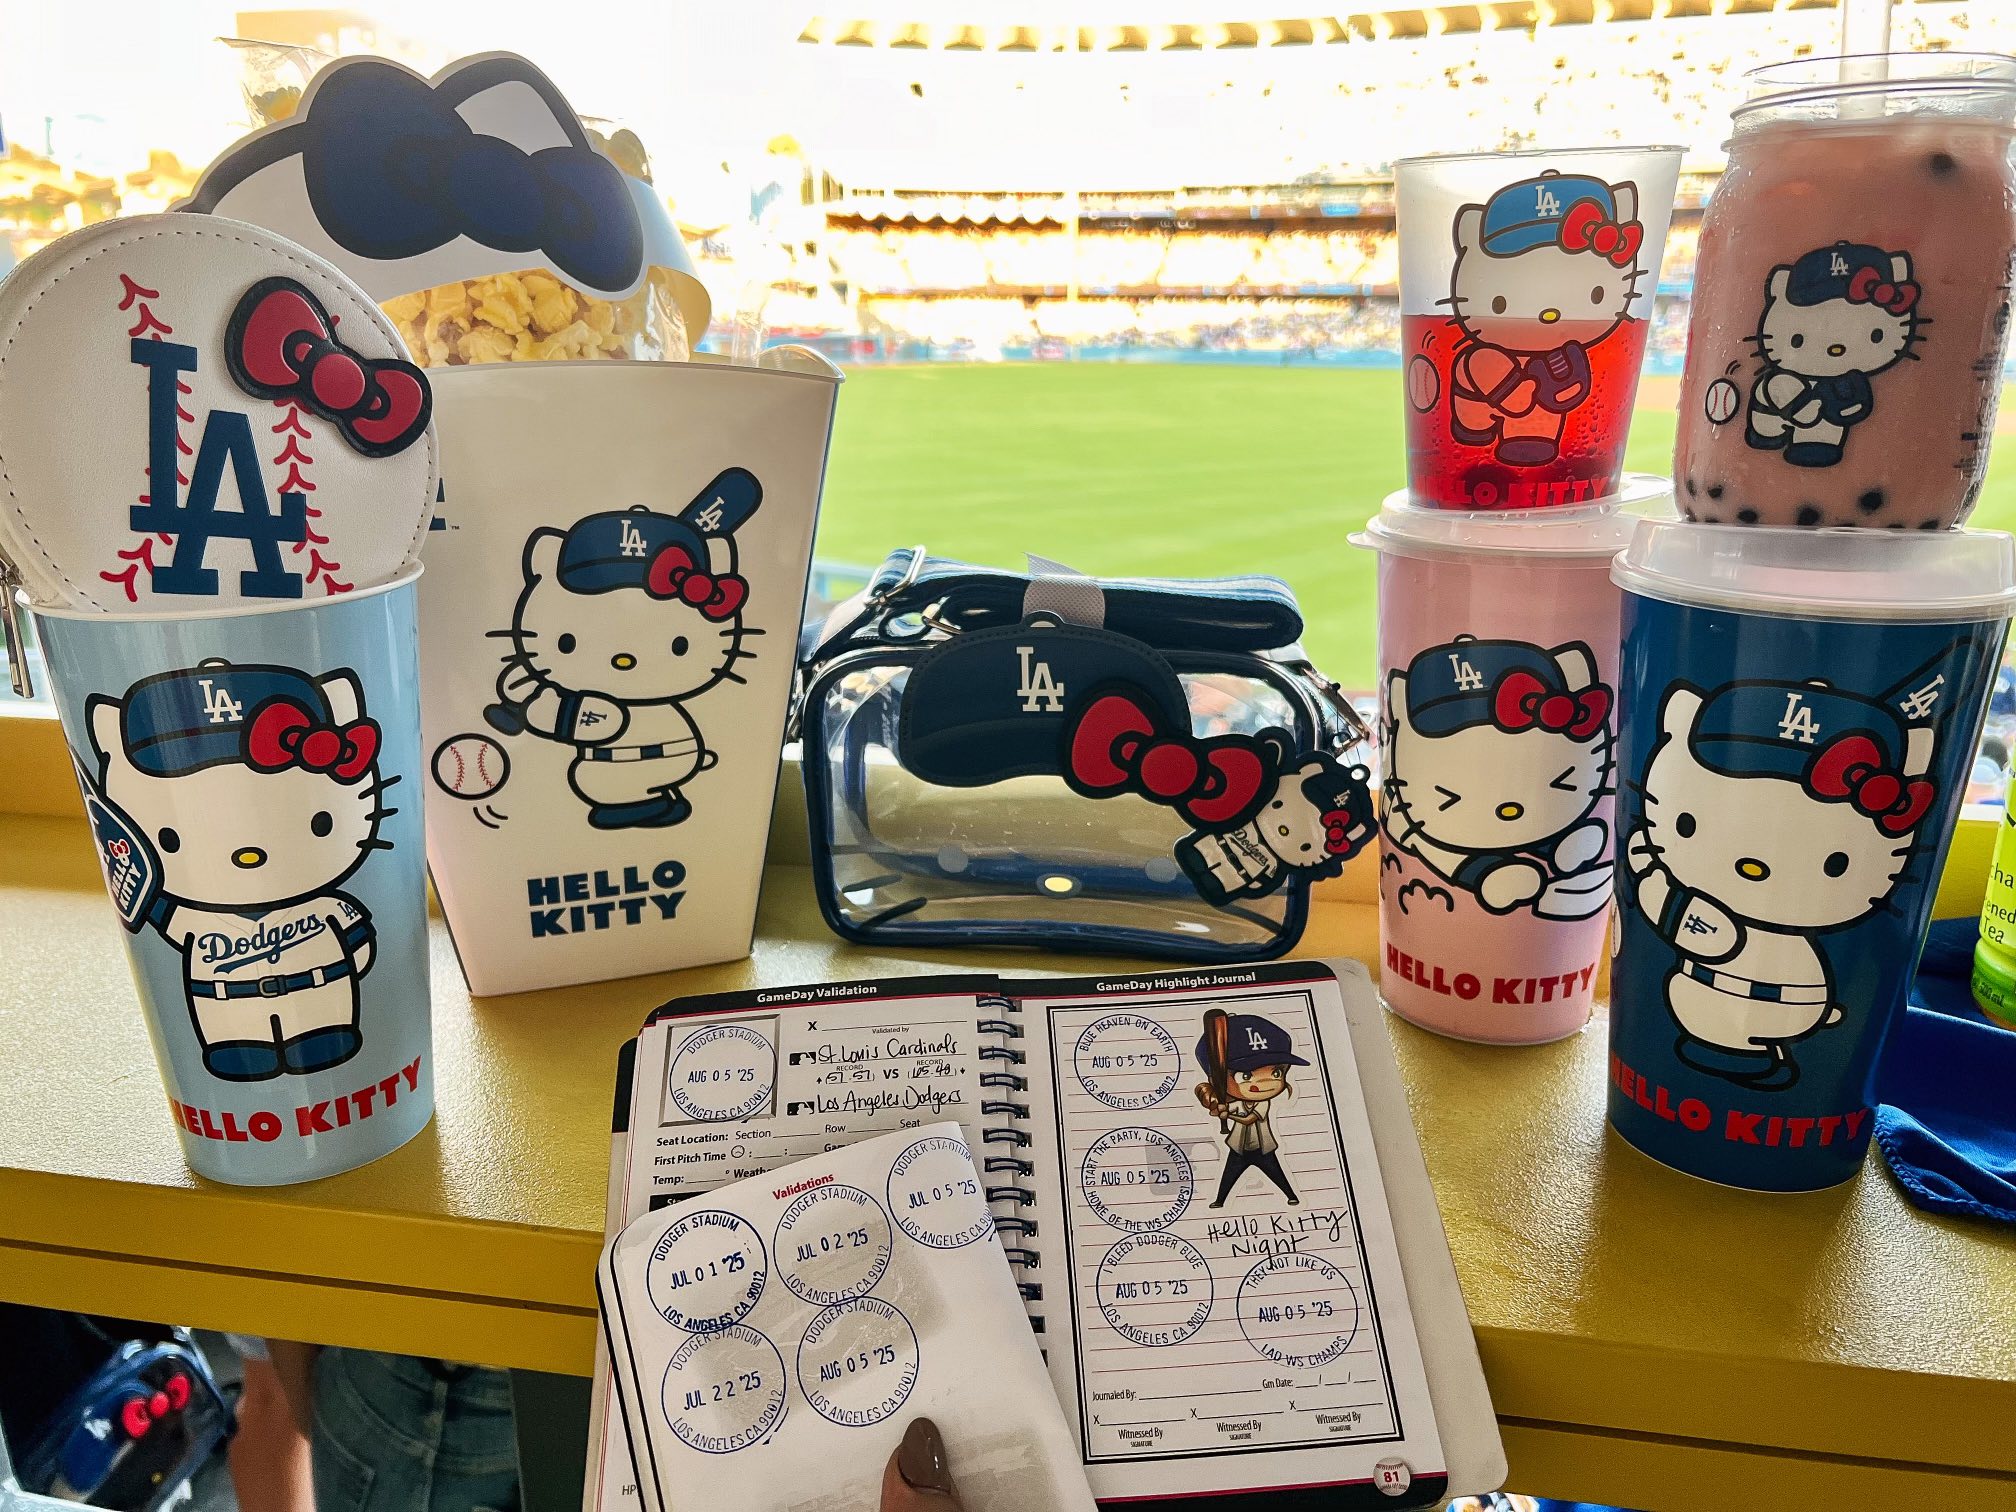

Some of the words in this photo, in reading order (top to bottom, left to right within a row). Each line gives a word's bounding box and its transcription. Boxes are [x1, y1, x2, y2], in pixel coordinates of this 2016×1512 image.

[1535, 184, 1561, 217] LA
[1830, 252, 1848, 276] LA
[130, 337, 306, 598] LA
[1507, 476, 1609, 507] KITTY
[695, 497, 725, 532] LA
[620, 519, 647, 556] LA
[1016, 646, 1064, 712] LA
[1449, 653, 1484, 692] LA
[198, 679, 242, 722] LA
[1900, 673, 1945, 720] LA
[1777, 692, 1819, 743] LA
[527, 860, 687, 906] HELLO
[337, 901, 360, 921] LA
[530, 890, 687, 938] KITTY
[1683, 912, 1719, 936] LA
[201, 914, 326, 974] Dodgers
[1984, 916, 2005, 945] Tea
[1096, 980, 1152, 992] GameDay
[1154, 975, 1210, 990] Highlight
[1211, 972, 1257, 984] Journal
[1387, 942, 1481, 1001] HELLO
[1492, 962, 1595, 1005] KITTY
[757, 989, 815, 1003] GameDay
[816, 985, 878, 998] Validation
[687, 1029, 725, 1054] DODGER
[728, 1029, 766, 1050] STADIUM
[872, 1026, 901, 1034] Validated
[887, 1033, 958, 1058] Cardinals
[1079, 1031, 1097, 1052] BLUE
[1095, 1017, 1131, 1033] HEAVEN
[1135, 1018, 1150, 1030] ON
[1150, 1026, 1174, 1053] EARTH
[1245, 1027, 1269, 1051] LA
[688, 1070, 707, 1083] AUG
[836, 1064, 864, 1072] RECORD
[883, 1069, 899, 1079] VS
[916, 1058, 944, 1066] RECORD
[1092, 1056, 1111, 1068] AUG
[295, 1055, 422, 1138] KITTY
[674, 1087, 688, 1105] LOS
[685, 1102, 728, 1120] ANGELES
[730, 1106, 744, 1117] CA
[743, 1083, 770, 1110] 90012
[817, 1094, 839, 1113] Los
[843, 1090, 899, 1116] Angeles
[902, 1085, 962, 1114] Dodgers
[1081, 1075, 1098, 1092] LOS
[1097, 1090, 1139, 1108] ANGELES
[1142, 1093, 1157, 1105] CA
[656, 1137, 679, 1147] Seat
[681, 1132, 729, 1145] Location:
[735, 1129, 771, 1140] Section
[825, 1124, 846, 1133] Row
[900, 1118, 921, 1128] Seat
[1725, 1107, 1866, 1149] KITTY
[654, 1155, 675, 1166] First
[677, 1153, 701, 1164] Pitch
[703, 1151, 727, 1161] Time
[894, 1143, 928, 1176] DODGER
[930, 1140, 972, 1162] STADIUM
[1086, 1157, 1098, 1186] START
[1093, 1140, 1111, 1156] THE
[1110, 1130, 1142, 1144] PARTY,
[1145, 1132, 1164, 1146] LOS
[1163, 1144, 1189, 1182] ANGELES
[653, 1175, 685, 1186] Temp:
[772, 1174, 834, 1200] Validations
[1101, 1171, 1121, 1185] AUG
[781, 1193, 819, 1230] DODGER
[820, 1188, 868, 1207] STADIUM
[908, 1191, 929, 1209] JUL
[1087, 1190, 1109, 1217] HOME
[1108, 1213, 1122, 1225] OF
[1124, 1219, 1142, 1231] THE
[1145, 1217, 1162, 1231] WS
[655, 1223, 689, 1261] DODGER
[692, 1214, 740, 1232] STADIUM
[900, 1216, 921, 1236] LOS
[920, 1231, 970, 1247] ANGELES
[969, 1223, 984, 1238] CA
[1207, 1216, 1258, 1244] Hello
[1270, 1210, 1348, 1243] Kitty
[796, 1243, 817, 1262] JUL
[1107, 1241, 1134, 1267] BLEED
[1136, 1234, 1178, 1250] DODGER
[1180, 1245, 1204, 1270] BLUE
[1231, 1234, 1310, 1271] Night
[670, 1270, 692, 1290] JUL
[786, 1273, 806, 1294] LOS
[805, 1287, 856, 1304] ANGELES
[856, 1278, 872, 1293] CA
[868, 1245, 889, 1280] 90012
[1245, 1265, 1269, 1290] THEY
[1271, 1257, 1290, 1271] NOT
[1295, 1256, 1318, 1271] LIKE
[1320, 1265, 1336, 1281] US
[663, 1305, 684, 1325] LOS
[684, 1312, 734, 1332] ANGELES
[734, 1301, 751, 1317] CA
[746, 1270, 765, 1301] 90012
[1115, 1282, 1137, 1299] AUG
[806, 1305, 844, 1344] DODGER
[846, 1300, 894, 1321] STADIUM
[1103, 1302, 1121, 1324] LOS
[1120, 1322, 1169, 1345] ANGELES
[1172, 1327, 1189, 1341] CA
[1186, 1302, 1209, 1330] 90012
[1259, 1306, 1280, 1323] AUG
[672, 1332, 712, 1371] DODGER
[715, 1326, 763, 1348] STADIUM
[1260, 1343, 1283, 1362] LAD
[1285, 1354, 1304, 1367] WS
[1308, 1335, 1348, 1366] CHAMPS
[820, 1360, 842, 1382] AUG
[1275, 1377, 1294, 1388] Date:
[684, 1390, 706, 1411] JUL
[809, 1390, 830, 1412] LOS
[828, 1406, 881, 1424] ANGELES
[881, 1397, 899, 1413] CA
[894, 1362, 916, 1399] 90012
[1092, 1390, 1125, 1401] Journaled
[672, 1417, 693, 1439] LOS
[691, 1433, 745, 1450] ANGELES
[745, 1424, 762, 1440] CA
[759, 1389, 783, 1427] 90012
[1118, 1428, 1153, 1440] Witnessed
[1154, 1427, 1164, 1440] By
[1216, 1421, 1251, 1433] Witnessed
[1252, 1420, 1262, 1432] By
[1315, 1412, 1351, 1425] Witnessed
[1352, 1411, 1362, 1424] By
[1383, 1471, 1400, 1483] 81
